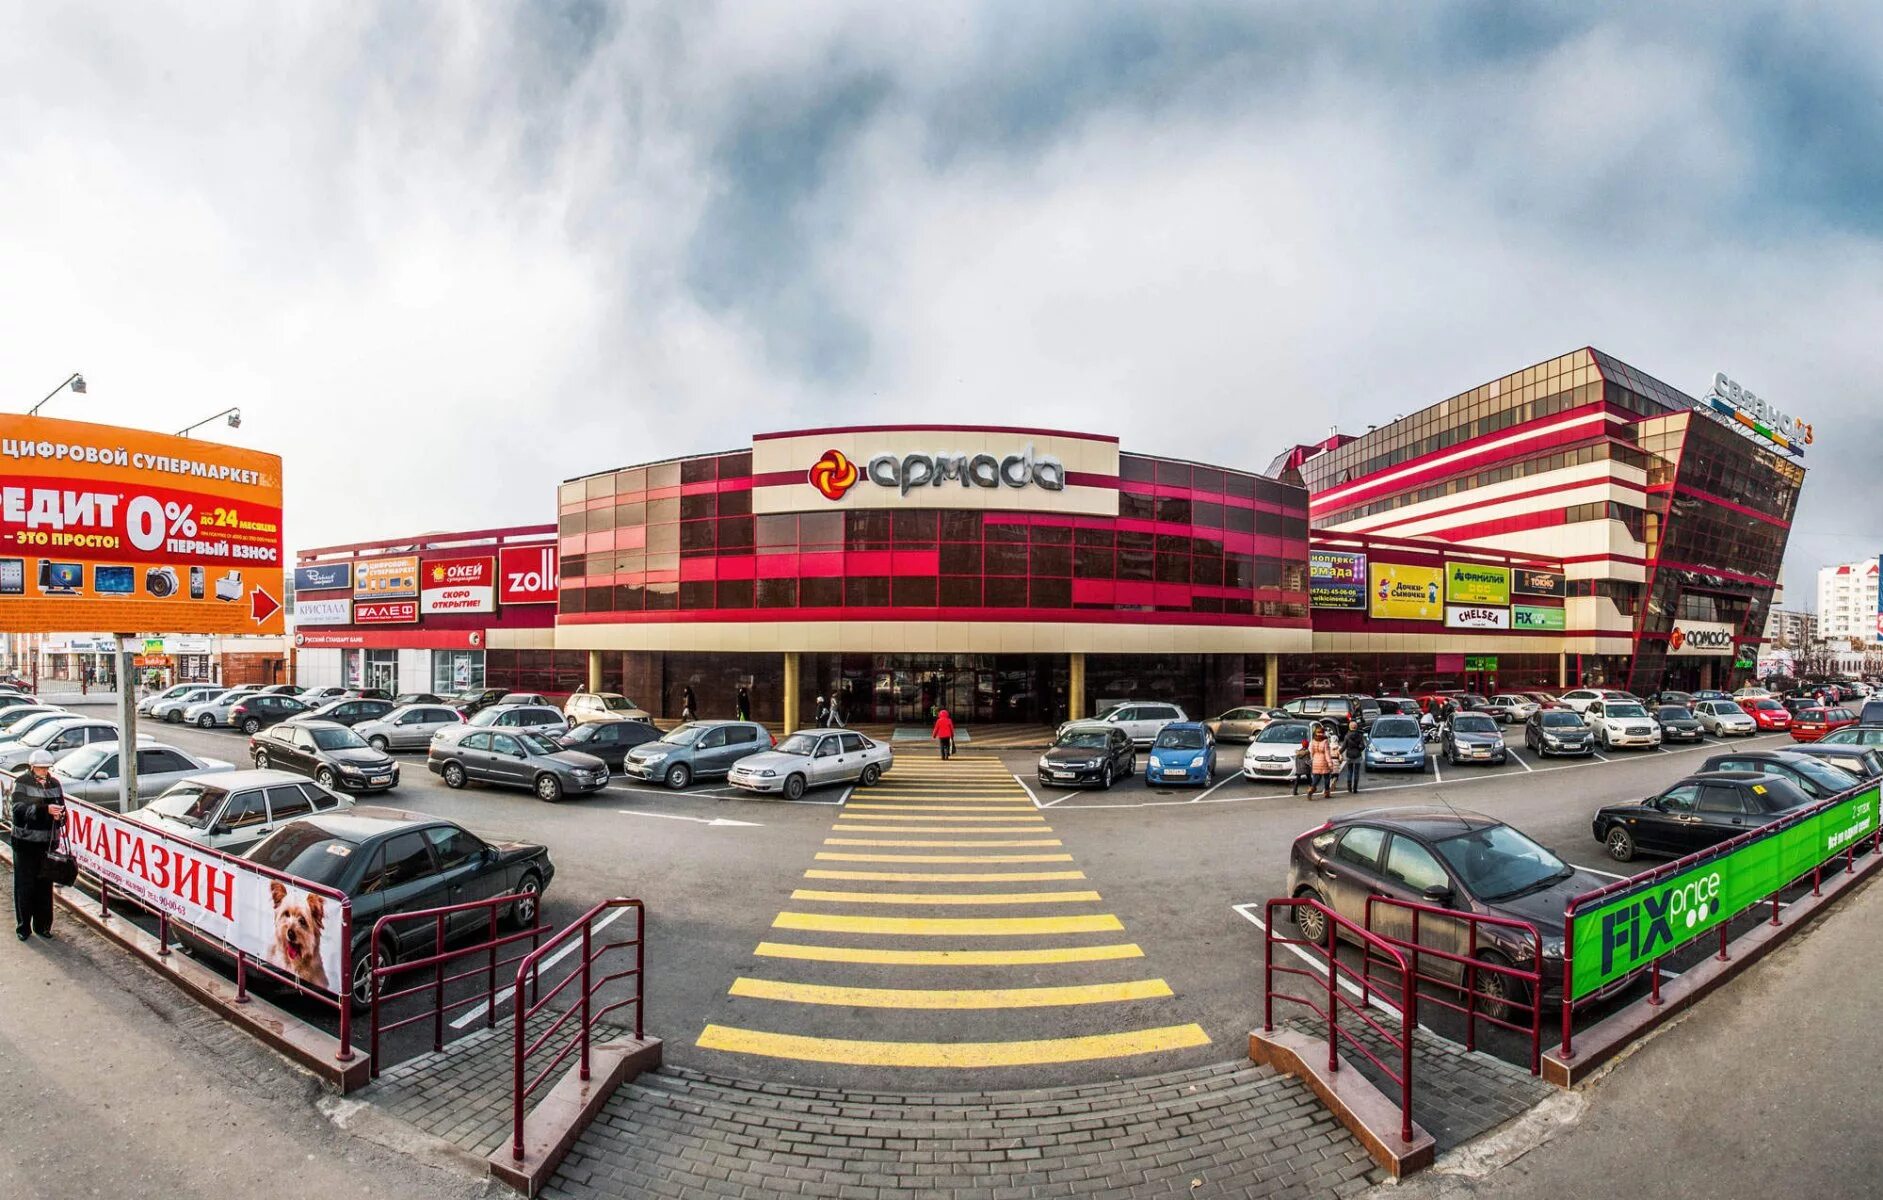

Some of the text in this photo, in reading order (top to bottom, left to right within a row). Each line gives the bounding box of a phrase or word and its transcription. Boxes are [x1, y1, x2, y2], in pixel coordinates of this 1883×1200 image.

[2, 438, 128, 467] ЦИФРОВОЙ
[132, 452, 259, 486] СУПЕРМАРКЕТ
[0, 486, 197, 551] ЕДИТ 0%
[200, 516, 214, 525] ДО
[214, 507, 238, 528] 24
[239, 520, 277, 533] МЕСЯЦЕВ
[17, 531, 48, 545] ЭТО
[52, 532, 119, 549] ПРОСТО!
[166, 538, 229, 557] ПЕРВЫЙ
[232, 544, 277, 562] ВЗНОС
[508, 548, 558, 592] zoll
[432, 599, 481, 609] ОТКРЫТИЕ!
[442, 590, 471, 599] СКОРО
[1458, 609, 1499, 625] CHELSEA
[159, 895, 187, 916] 90-00-63
[1670, 872, 1720, 925] price
